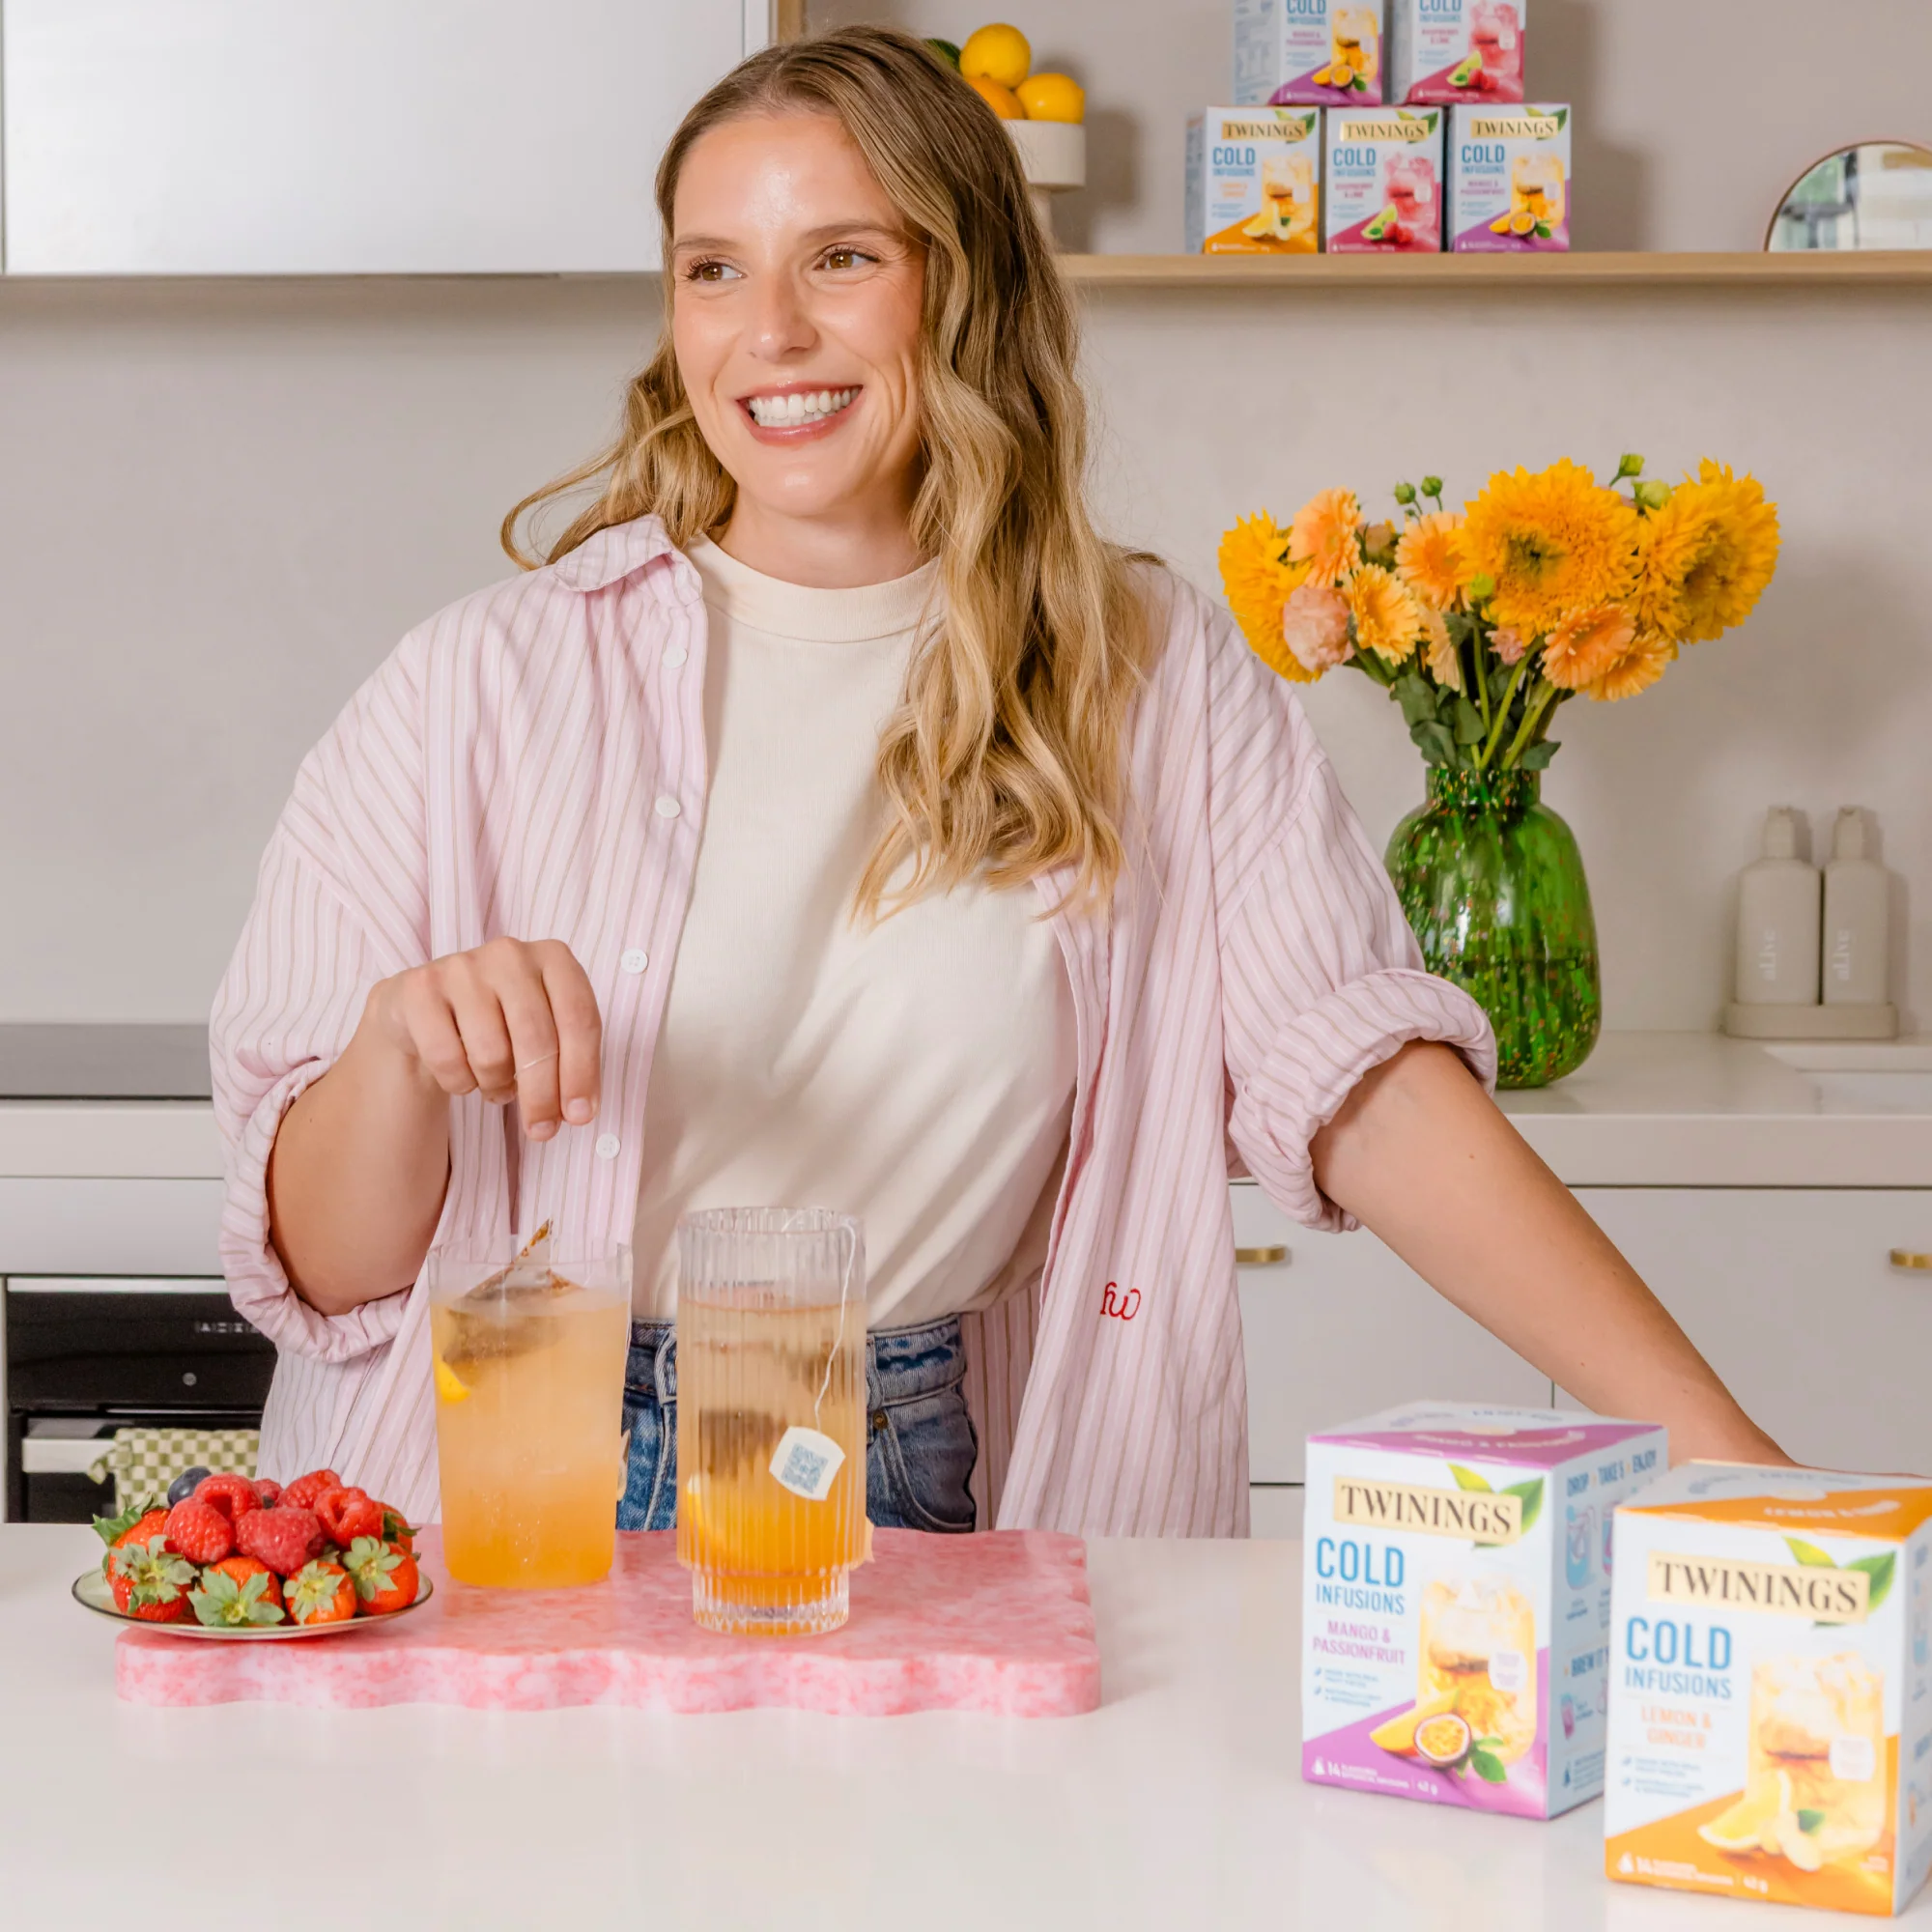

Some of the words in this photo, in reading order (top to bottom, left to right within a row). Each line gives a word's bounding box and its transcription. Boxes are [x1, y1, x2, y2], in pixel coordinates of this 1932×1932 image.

[1287, 0, 1326, 14] COLD
[1225, 124, 1303, 137] TWININGS
[1346, 124, 1425, 138] TWININGS
[1475, 121, 1554, 135] TWININGS
[1212, 147, 1255, 166] COLD
[1333, 148, 1376, 166] COLD
[1462, 144, 1505, 163] COLD
[1341, 1484, 1512, 1536] TWININGS
[1316, 1537, 1406, 1587] COLD
[1656, 1560, 1858, 1614] TWININGS
[1316, 1583, 1406, 1616] INFUSIONS
[1327, 1620, 1378, 1641] MANGO
[1381, 1628, 1391, 1644] &
[1626, 1616, 1731, 1670] COLD
[1312, 1635, 1406, 1665] PASSIONFRUIT
[1625, 1666, 1731, 1699] INFUSIONS
[1641, 1705, 1697, 1727] LEMON
[1647, 1727, 1706, 1749] GINGER
